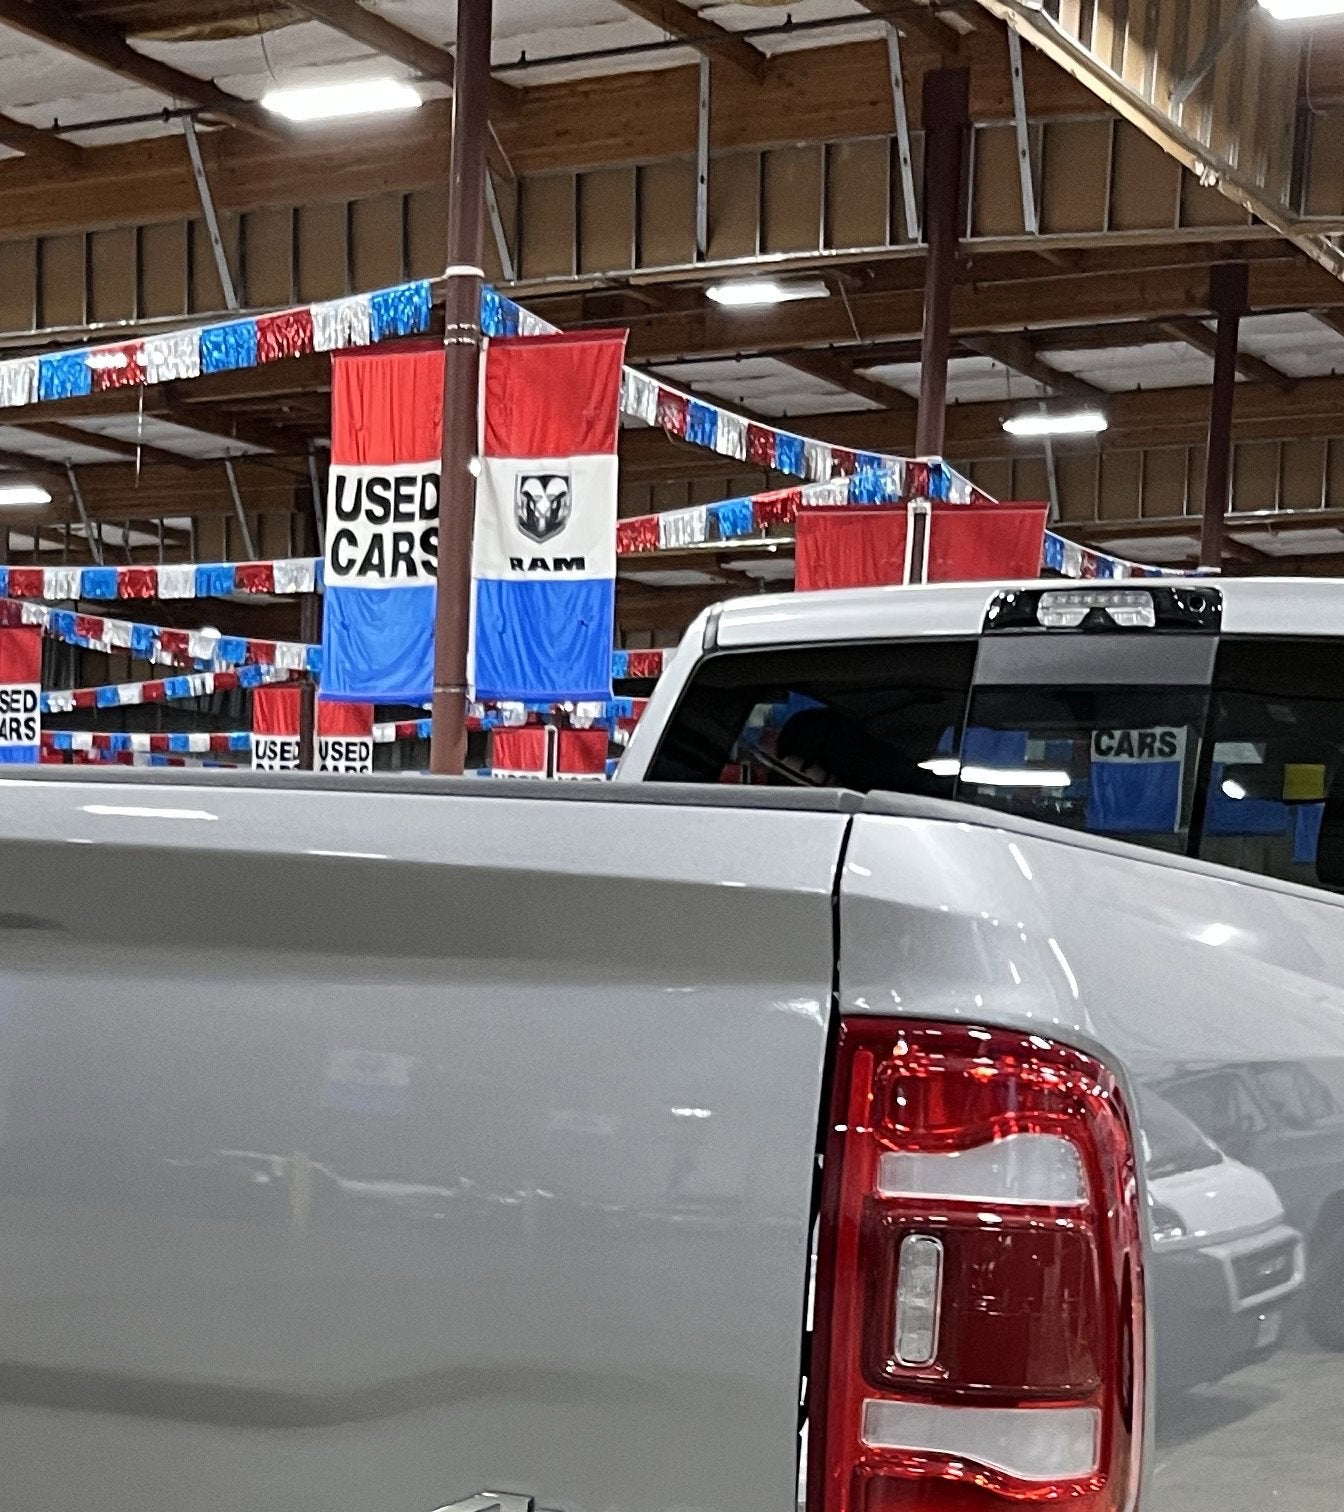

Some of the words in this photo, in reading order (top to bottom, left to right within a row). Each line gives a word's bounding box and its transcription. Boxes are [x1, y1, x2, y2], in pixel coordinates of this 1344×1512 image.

[335, 472, 440, 523] USED
[330, 527, 439, 579] CARS
[510, 555, 586, 571] RAM
[319, 740, 370, 761] USED
[1094, 729, 1177, 758] CARS
